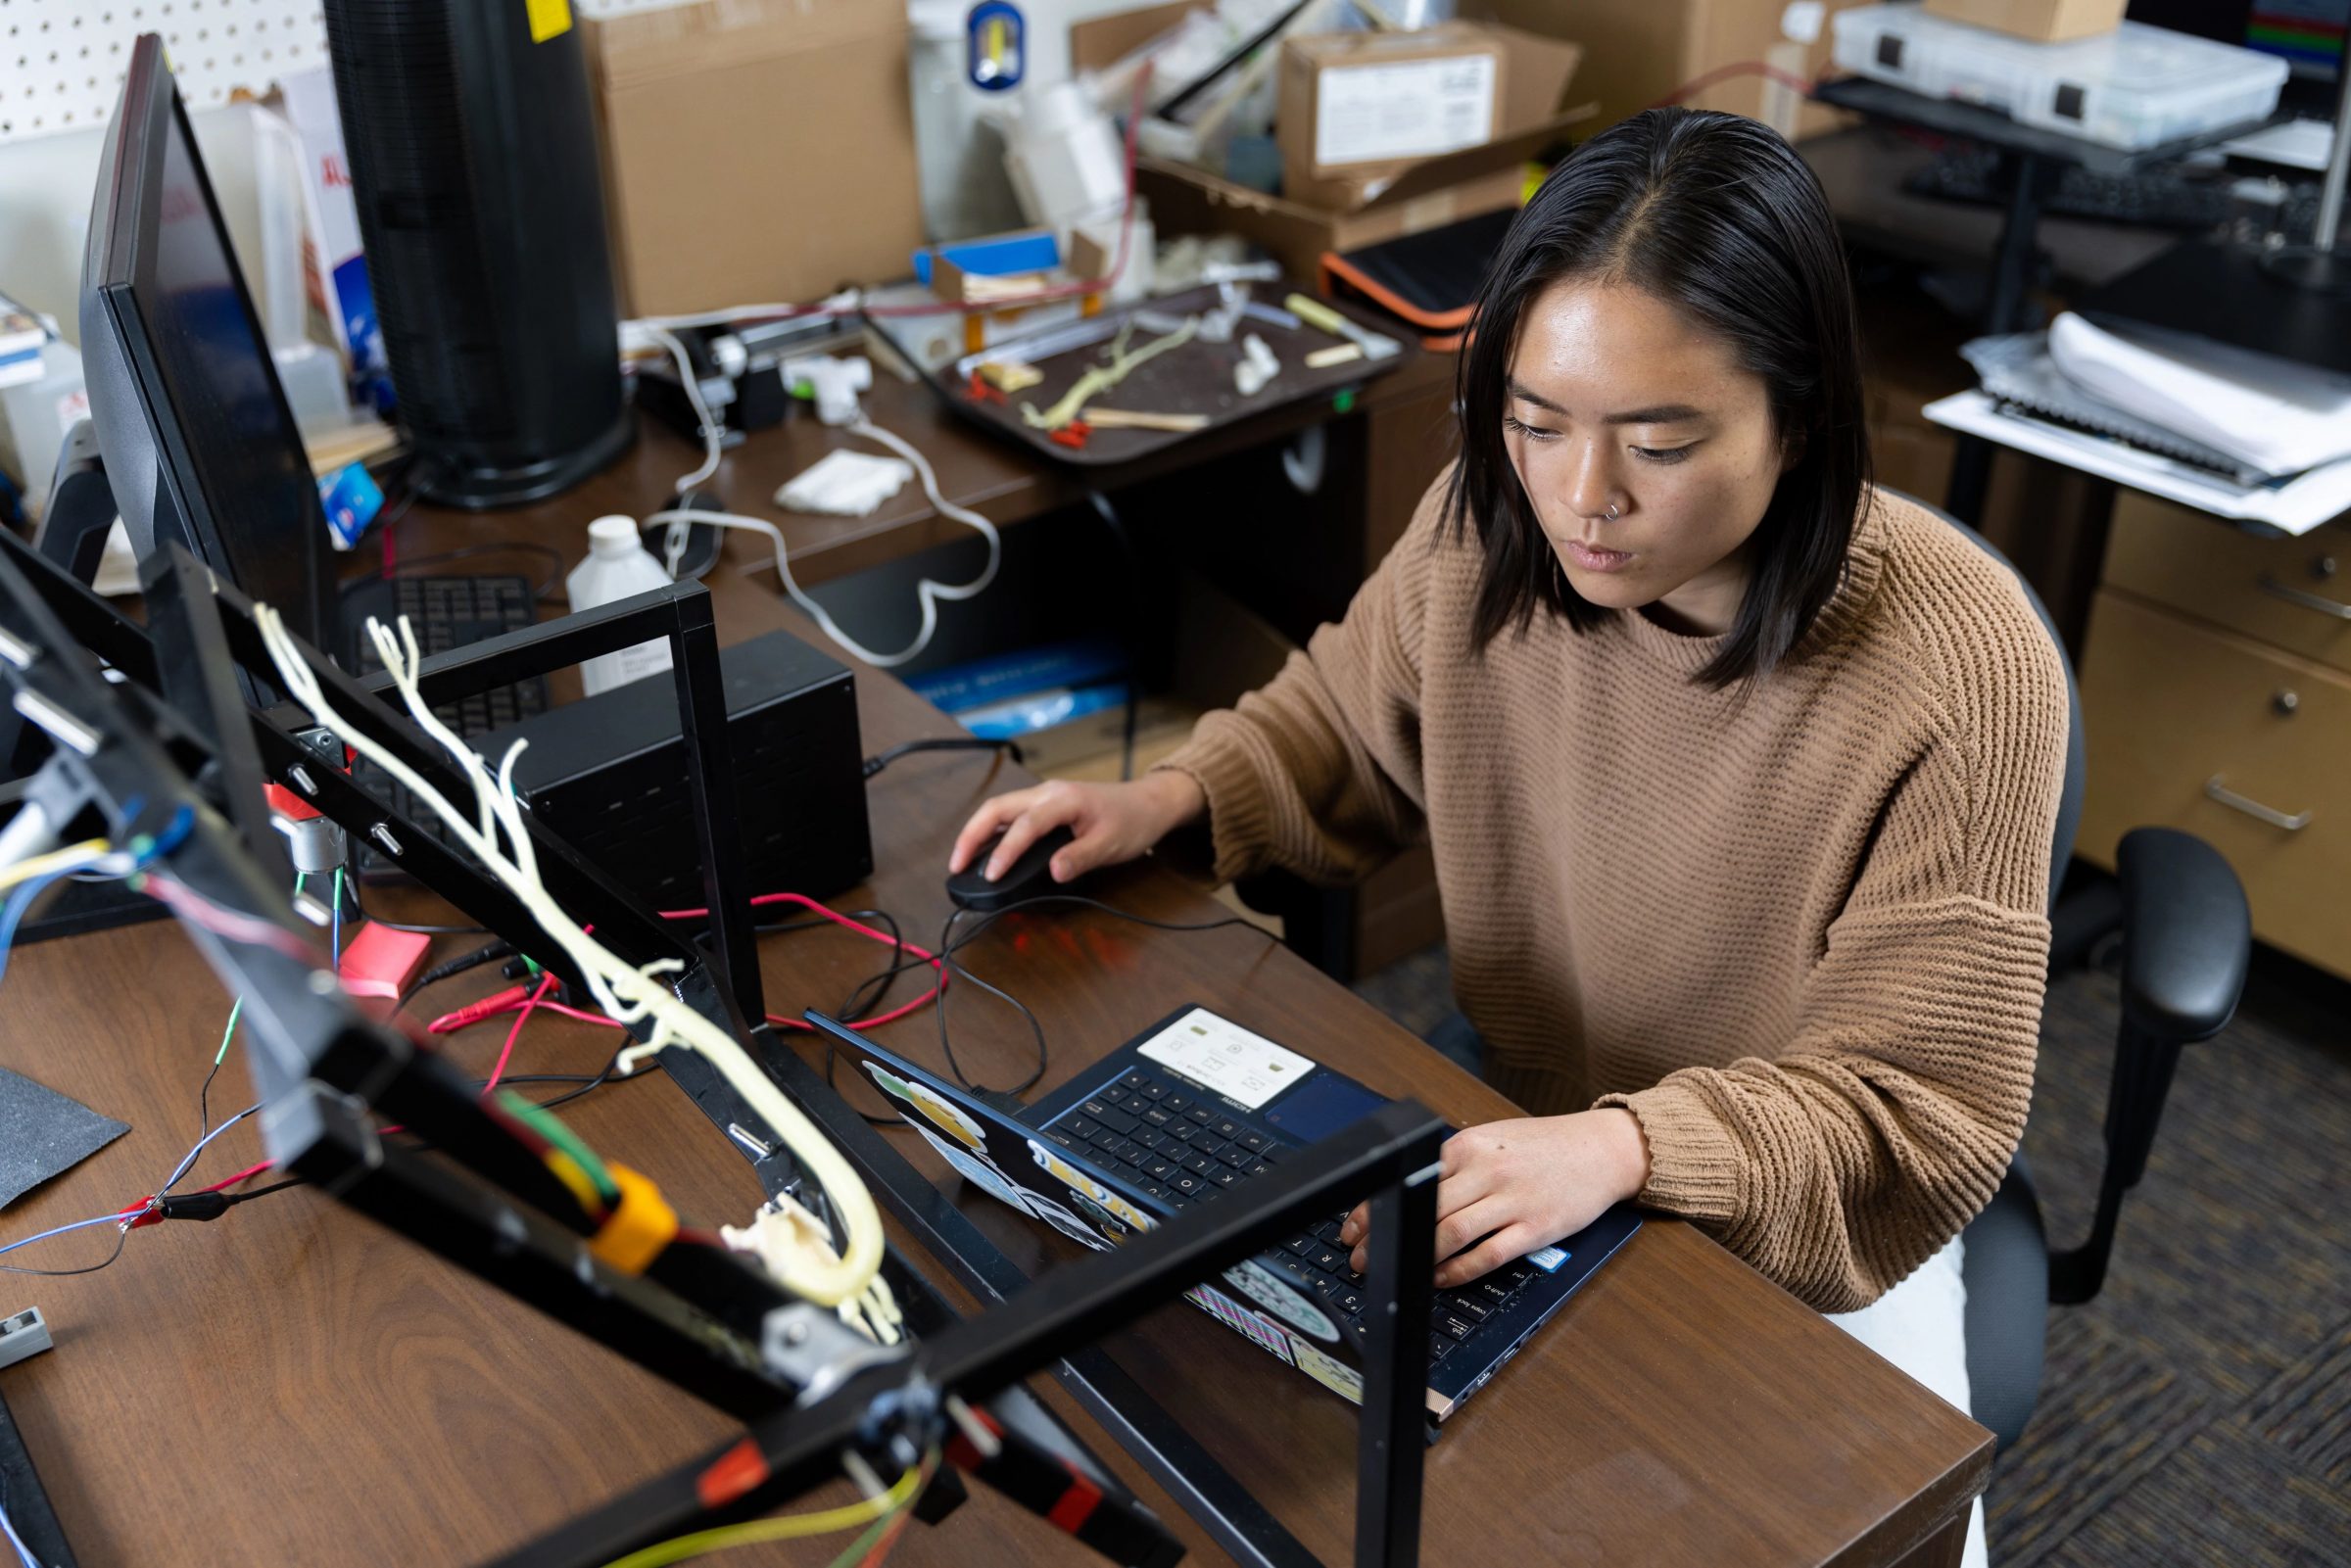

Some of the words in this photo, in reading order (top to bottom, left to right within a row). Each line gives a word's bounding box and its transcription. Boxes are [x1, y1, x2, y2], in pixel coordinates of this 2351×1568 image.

[1196, 1160, 1207, 1168] L
[1222, 1174, 1234, 1183] K
[1292, 1239, 1303, 1248] T
[1321, 1254, 1332, 1262] R
[1456, 1298, 1470, 1308] lock
[1469, 1305, 1487, 1315] caps
[1452, 1327, 1463, 1336] tab
